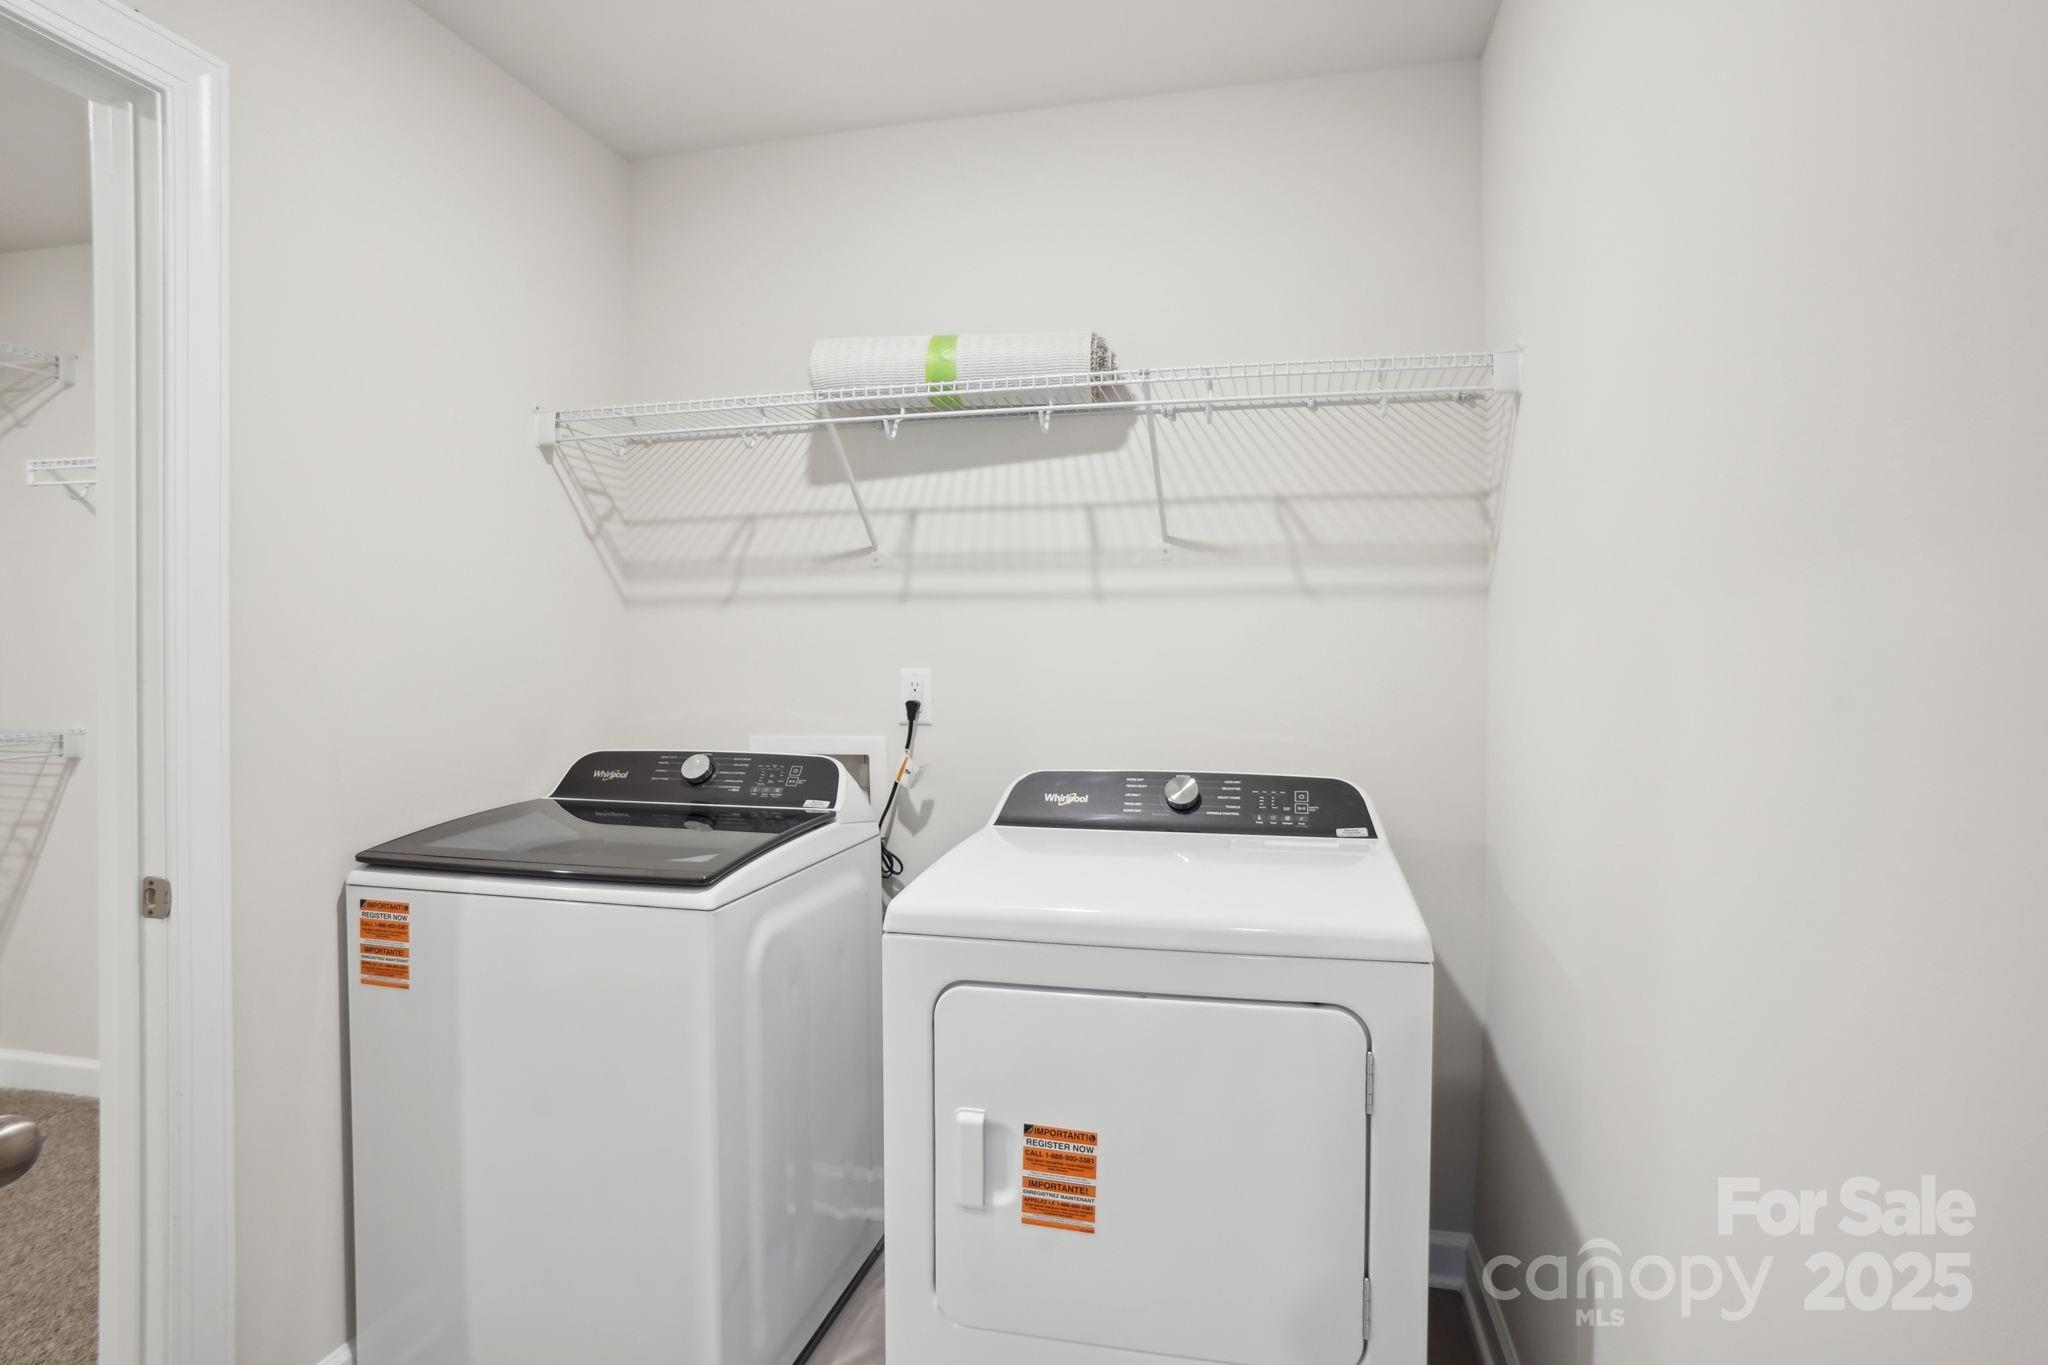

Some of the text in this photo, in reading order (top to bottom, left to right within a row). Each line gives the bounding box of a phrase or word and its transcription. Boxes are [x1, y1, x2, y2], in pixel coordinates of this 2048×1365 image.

[593, 769, 629, 781] Whirlpool
[1044, 793, 1089, 806] Whirlpool
[367, 901, 404, 912] IMPORTANT!
[362, 911, 392, 920] REGISTER
[364, 946, 404, 956] IMPORTANTE!
[1034, 1127, 1088, 1141] IMPORTANT!
[1026, 1138, 1094, 1154] REGISTER NOW
[1024, 1149, 1043, 1158] CALL
[1028, 1180, 1088, 1195] IMPORTANTE!
[1022, 1188, 1094, 1204] ENREGISTREZ MAINTENANT
